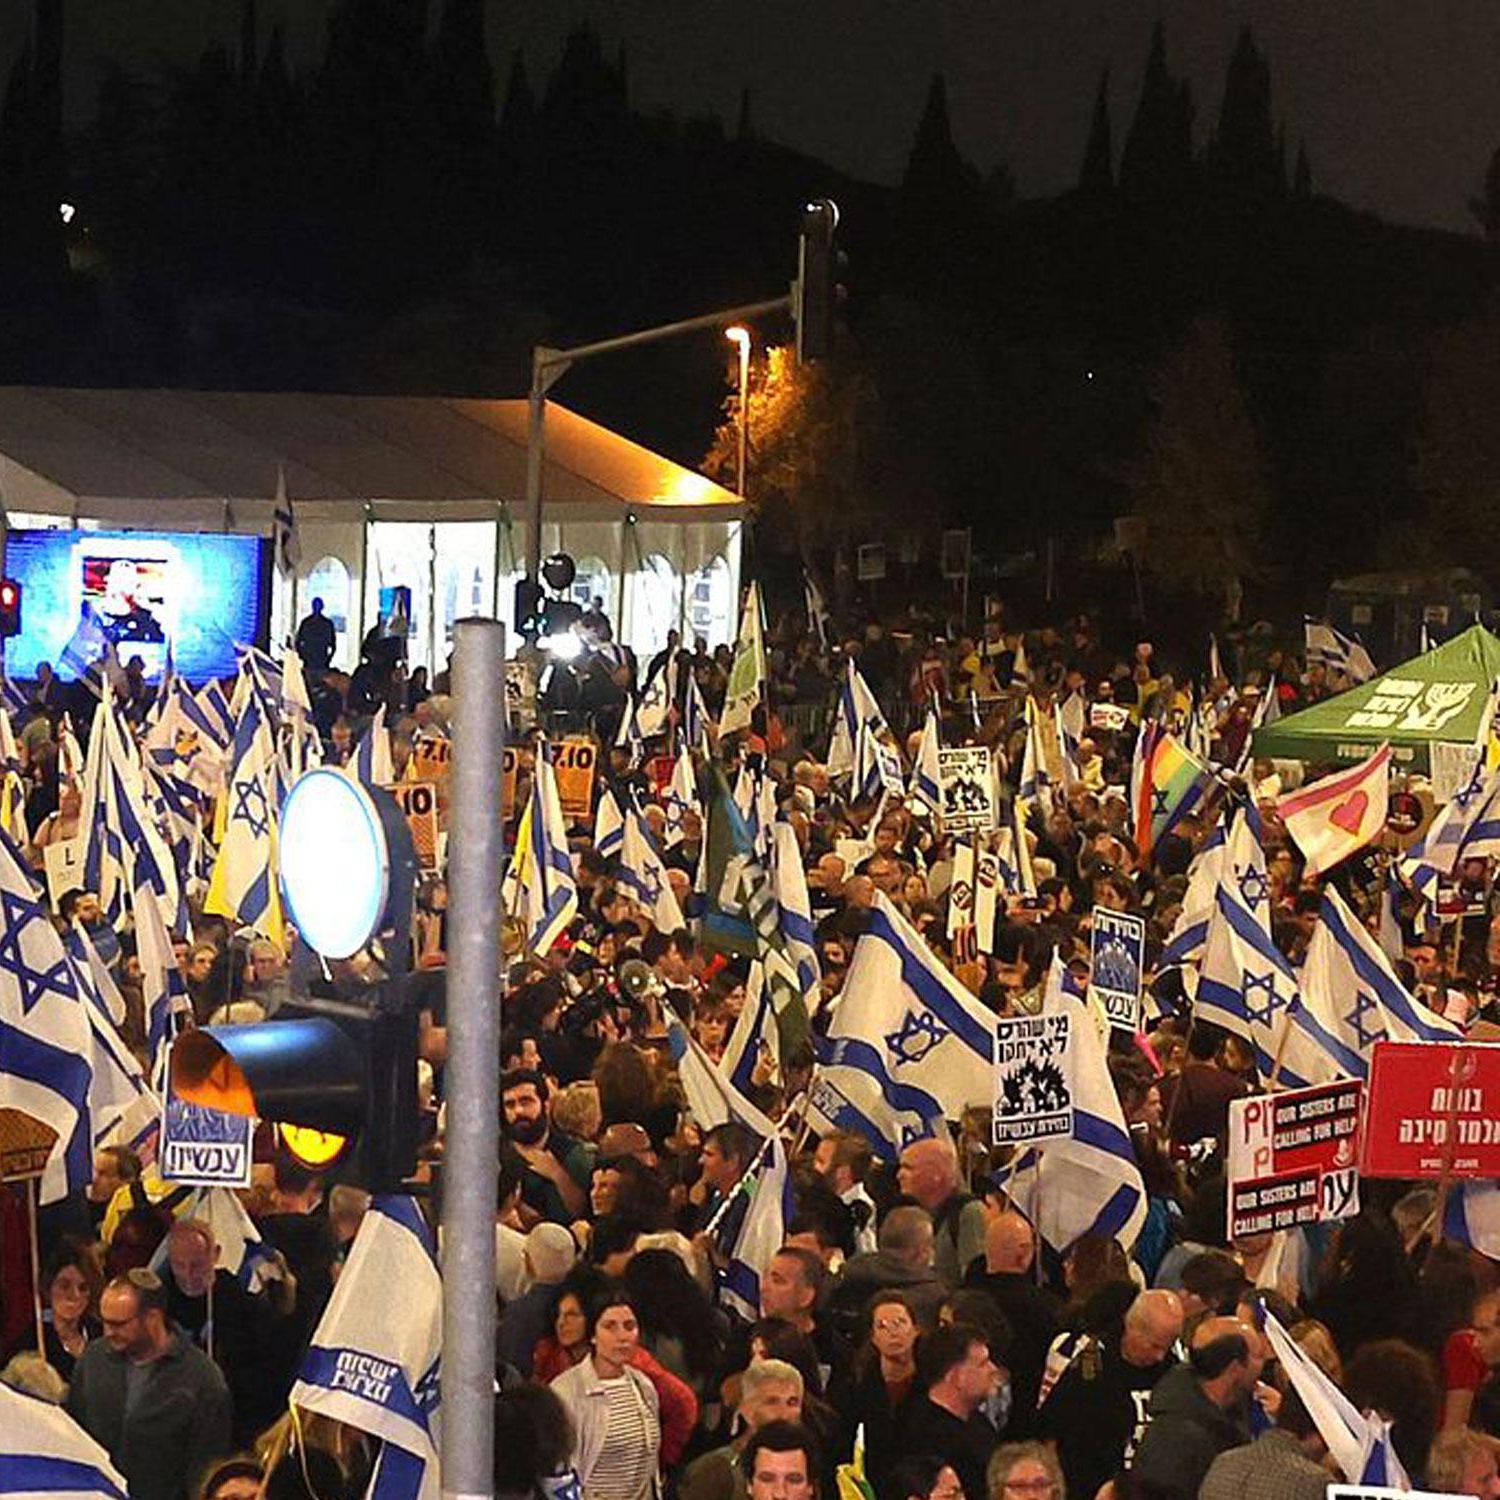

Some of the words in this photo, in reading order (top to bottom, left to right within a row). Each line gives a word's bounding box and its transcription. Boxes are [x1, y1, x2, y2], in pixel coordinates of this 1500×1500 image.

[1048, 1015, 1068, 1034] מי
[1040, 1036, 1067, 1057] לא
[1276, 1106, 1297, 1124] OUR
[1300, 1098, 1336, 1119] SISTERS
[1338, 1093, 1357, 1110] ARE
[1274, 1127, 1312, 1149] CALLING
[1313, 1122, 1332, 1140] FOR
[1236, 1191, 1257, 1210] OUR
[1260, 1184, 1297, 1205] SISTERS
[1234, 1214, 1273, 1235] CALLING
[1275, 1209, 1294, 1226] FOR
